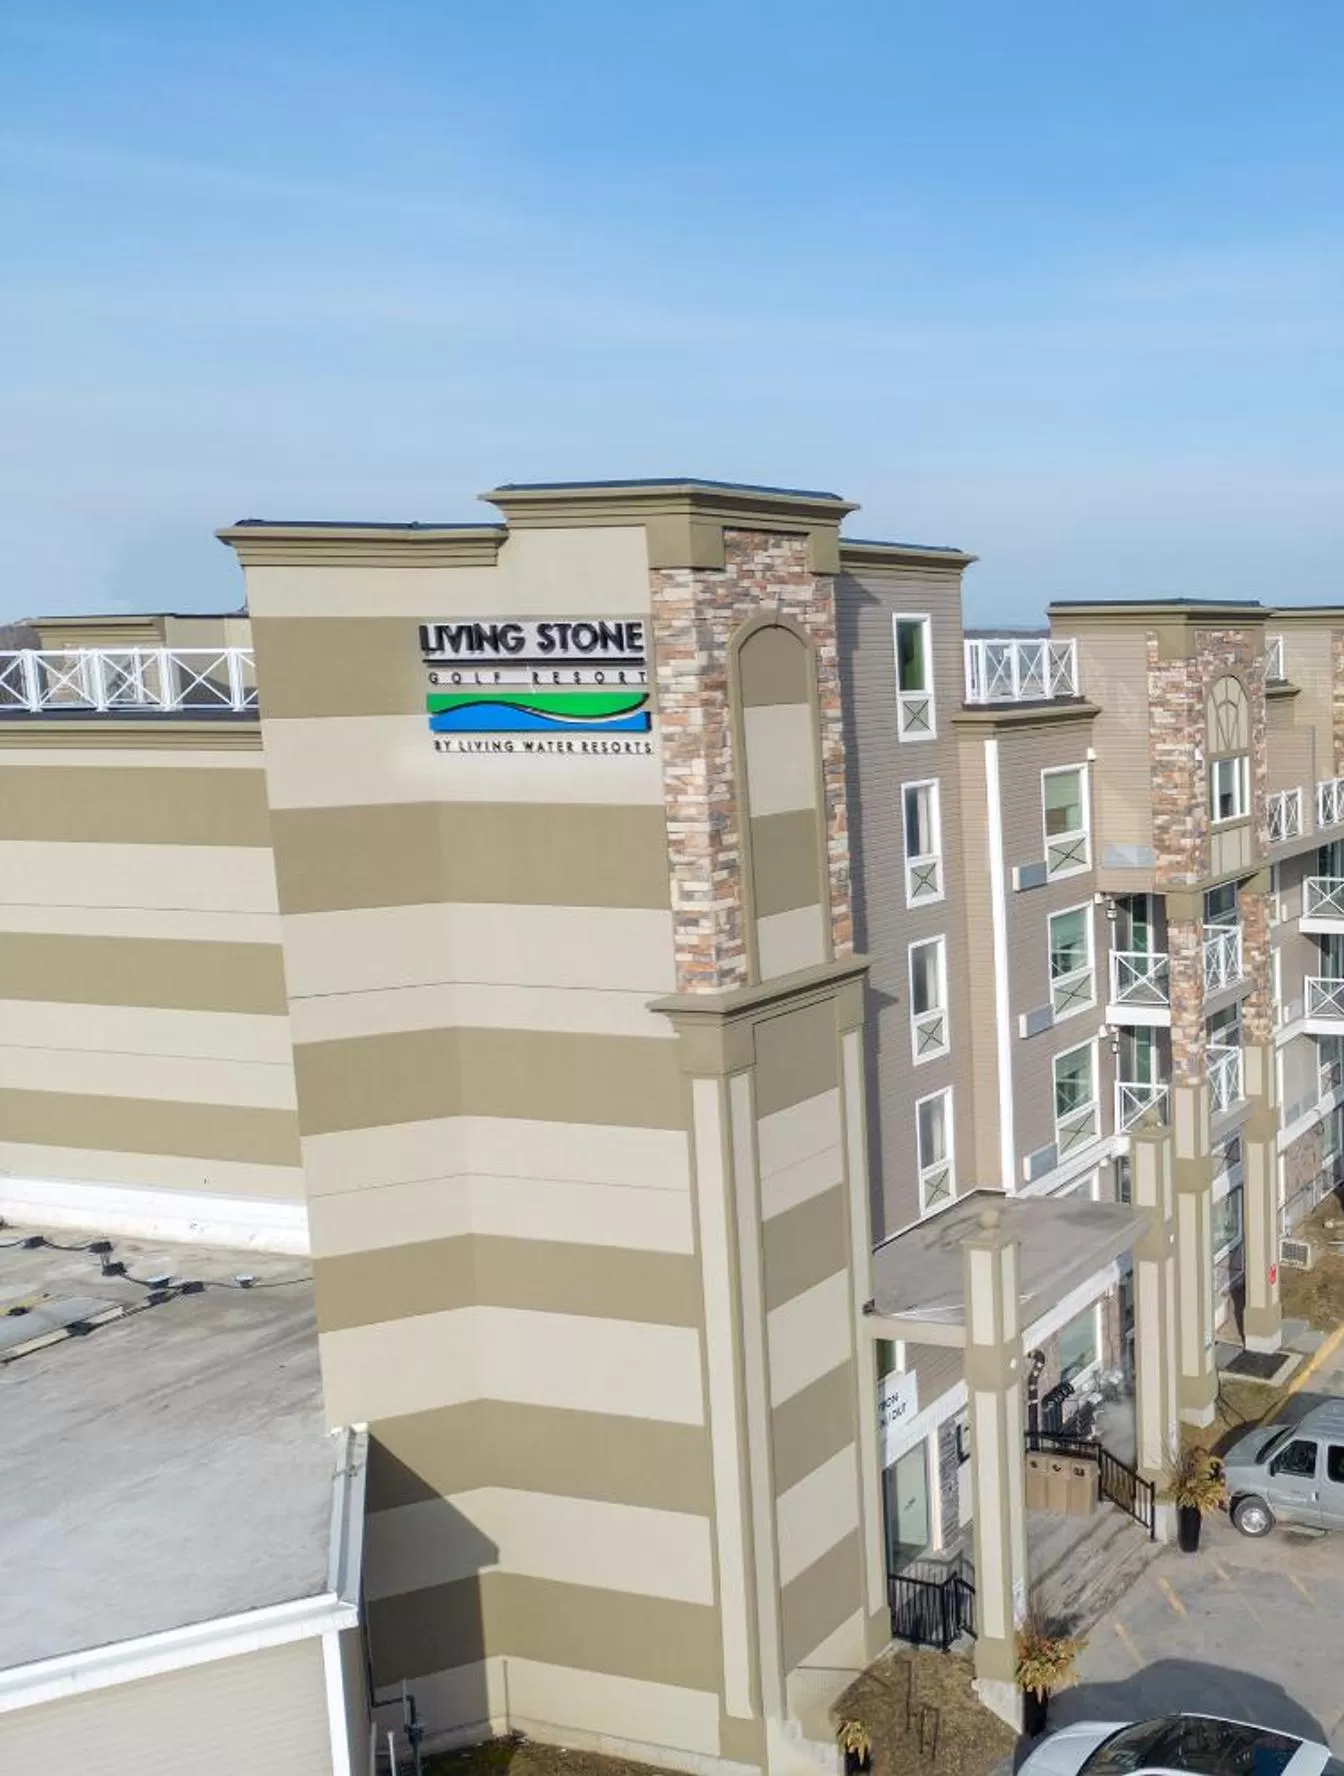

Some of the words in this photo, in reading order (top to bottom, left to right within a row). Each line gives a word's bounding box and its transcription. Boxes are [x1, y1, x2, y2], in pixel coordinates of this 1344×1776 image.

[419, 623, 526, 654] LIVING
[536, 621, 644, 653] STONE
[428, 671, 501, 685] GOLF
[531, 671, 647, 685] RESORT
[434, 739, 451, 752] BY
[458, 740, 514, 753] LIVING
[523, 740, 575, 753] WATER
[581, 740, 652, 754] RESORTS
